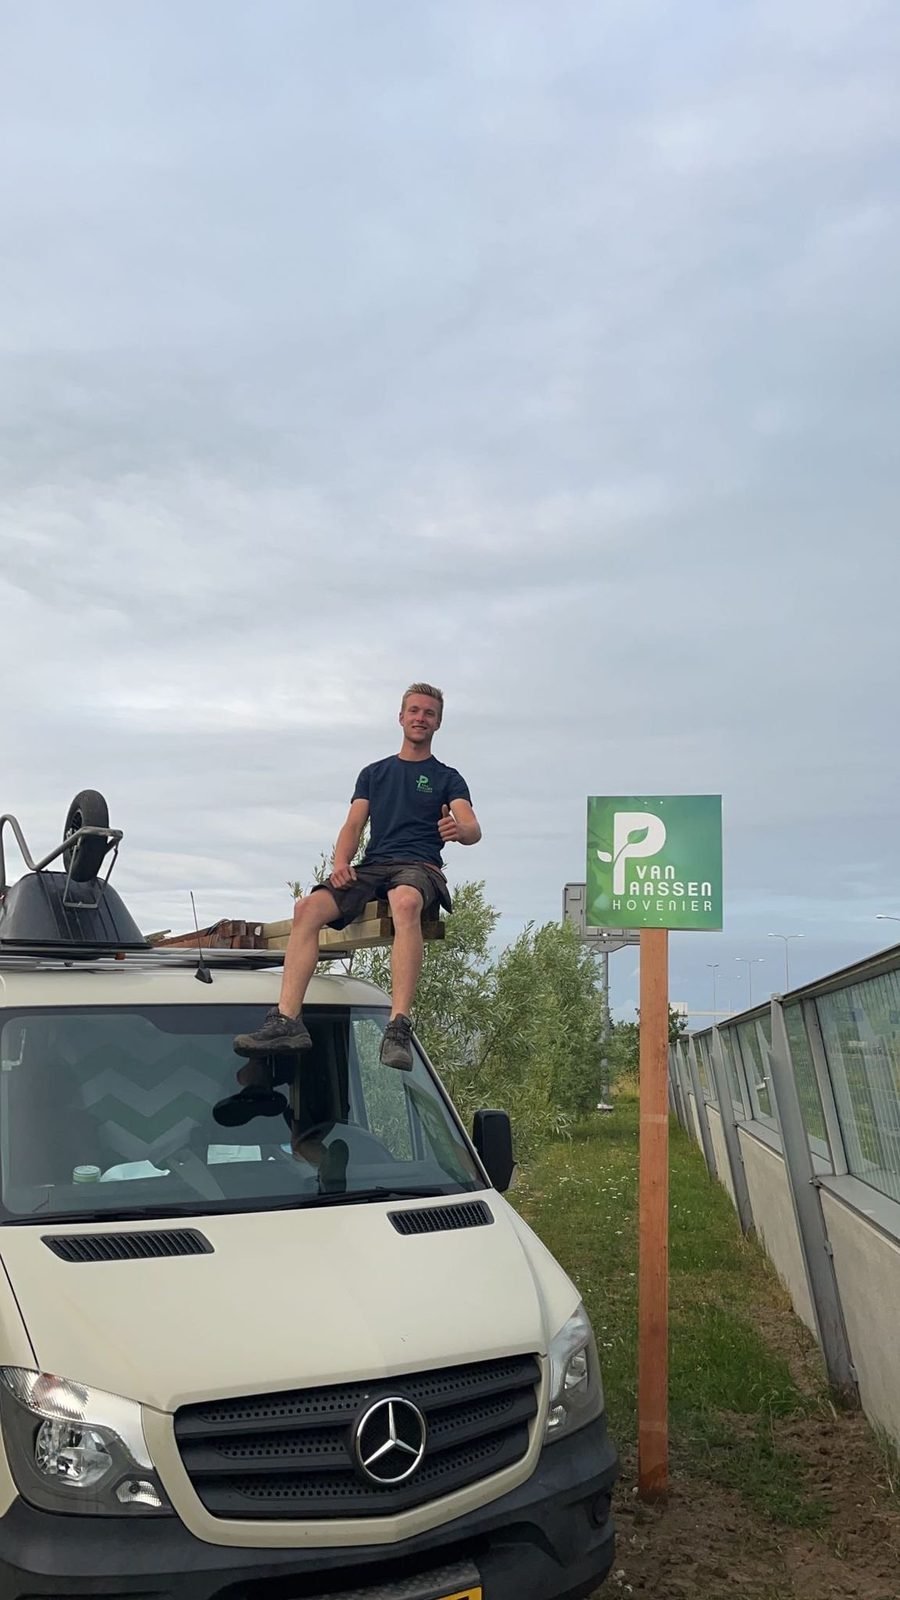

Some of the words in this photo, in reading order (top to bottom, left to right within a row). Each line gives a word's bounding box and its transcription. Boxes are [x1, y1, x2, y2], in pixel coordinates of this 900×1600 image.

[614, 812, 666, 895] P
[636, 865, 675, 880] VAN
[630, 882, 711, 896] AASSEN
[612, 899, 713, 912] HOVENIER
